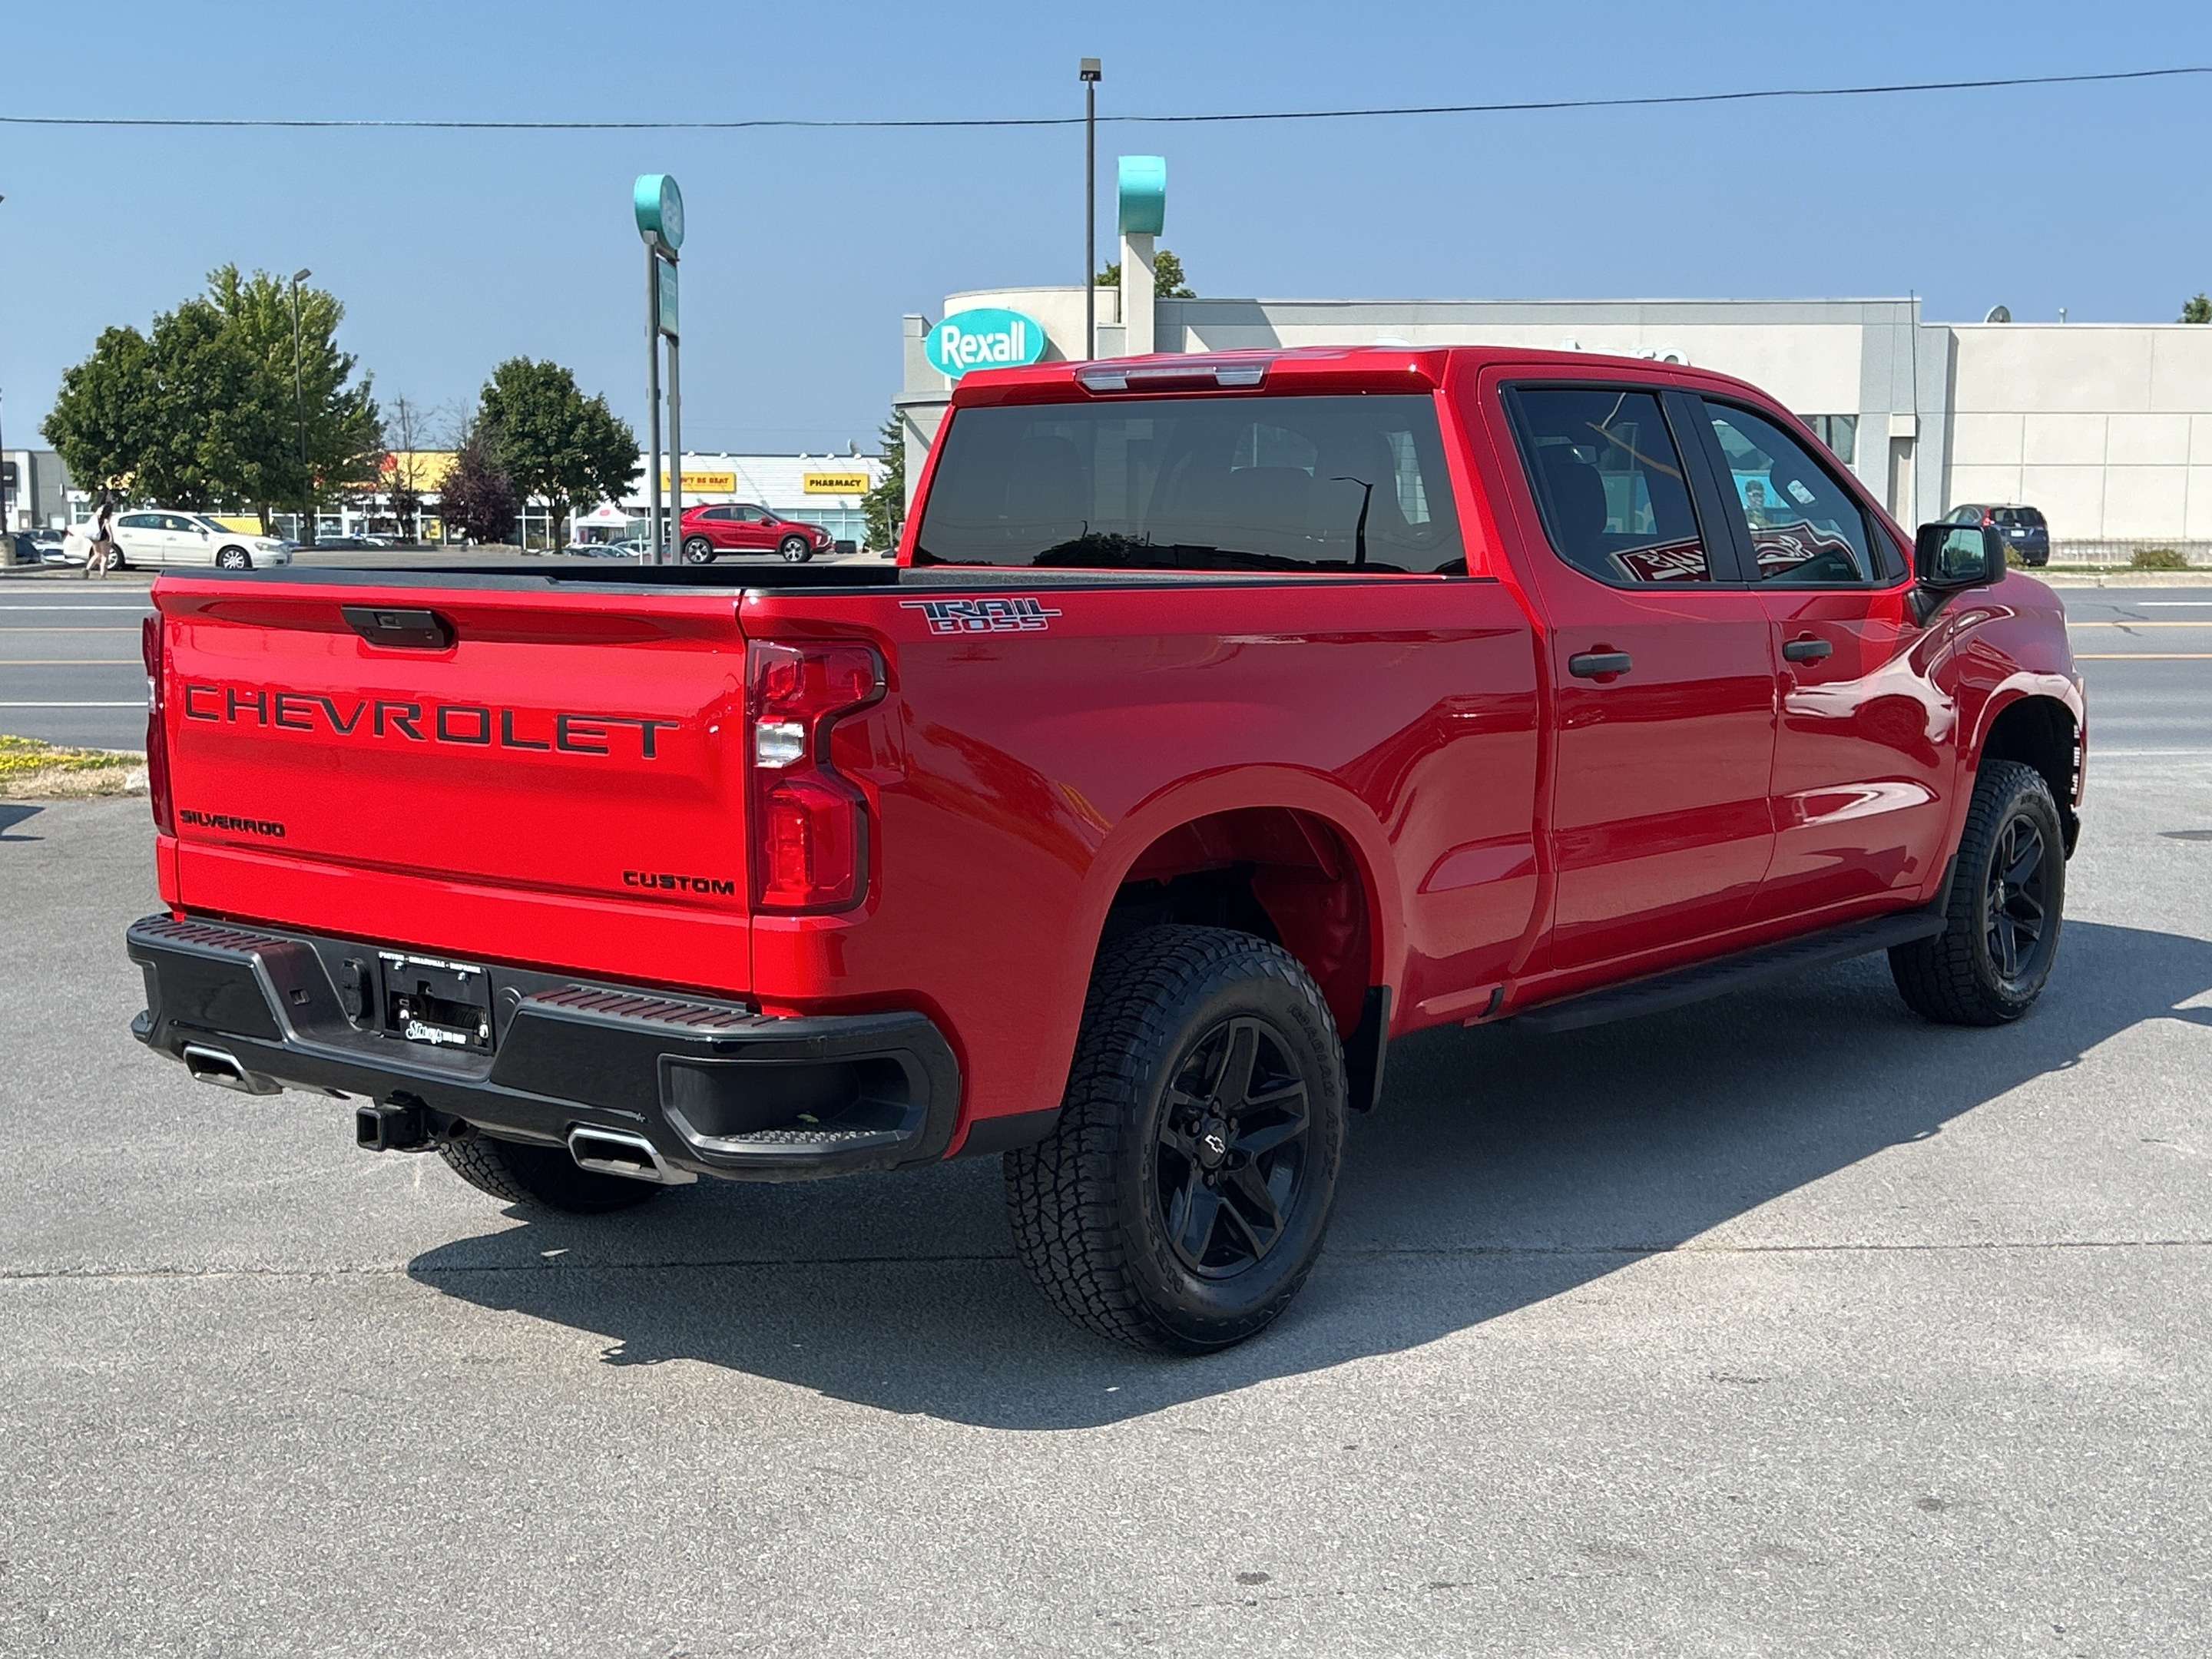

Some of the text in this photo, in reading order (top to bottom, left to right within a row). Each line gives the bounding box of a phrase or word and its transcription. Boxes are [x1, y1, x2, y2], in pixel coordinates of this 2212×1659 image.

[941, 320, 1025, 369] Rexall
[899, 598, 1063, 620] TRAIL
[927, 615, 1056, 635] BOSS
[184, 684, 680, 759] CHEVROLET
[180, 810, 286, 839] SILVERADO
[622, 869, 735, 896] CUSTOM
